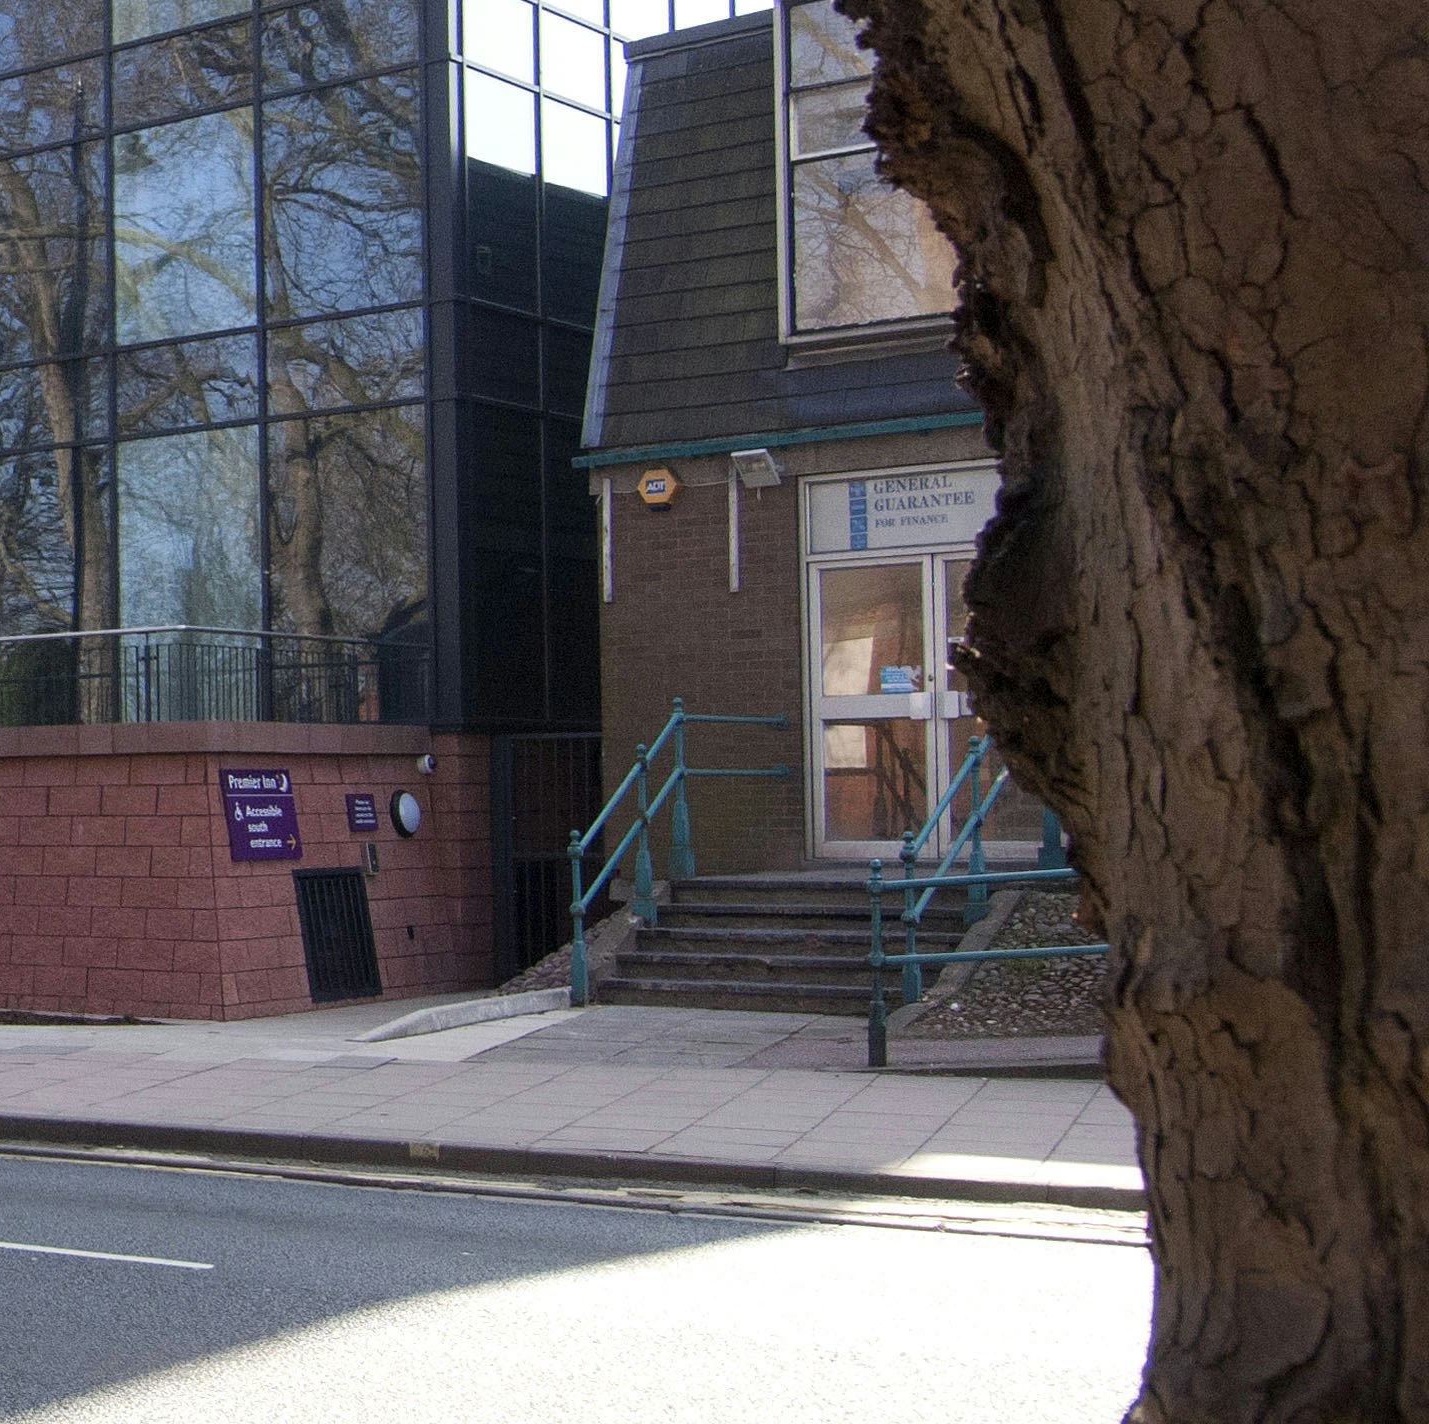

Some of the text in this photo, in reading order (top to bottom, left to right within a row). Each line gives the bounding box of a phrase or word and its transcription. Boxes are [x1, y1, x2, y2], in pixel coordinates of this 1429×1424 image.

[646, 480, 664, 494] ADT
[873, 475, 952, 494] GENERAL
[874, 491, 975, 512] GUARANTEE
[875, 514, 949, 528] FOR FINANCE
[228, 774, 278, 789] Premier Inn
[246, 805, 283, 817] Accessible
[248, 821, 268, 833] south
[250, 838, 283, 848] entrance
